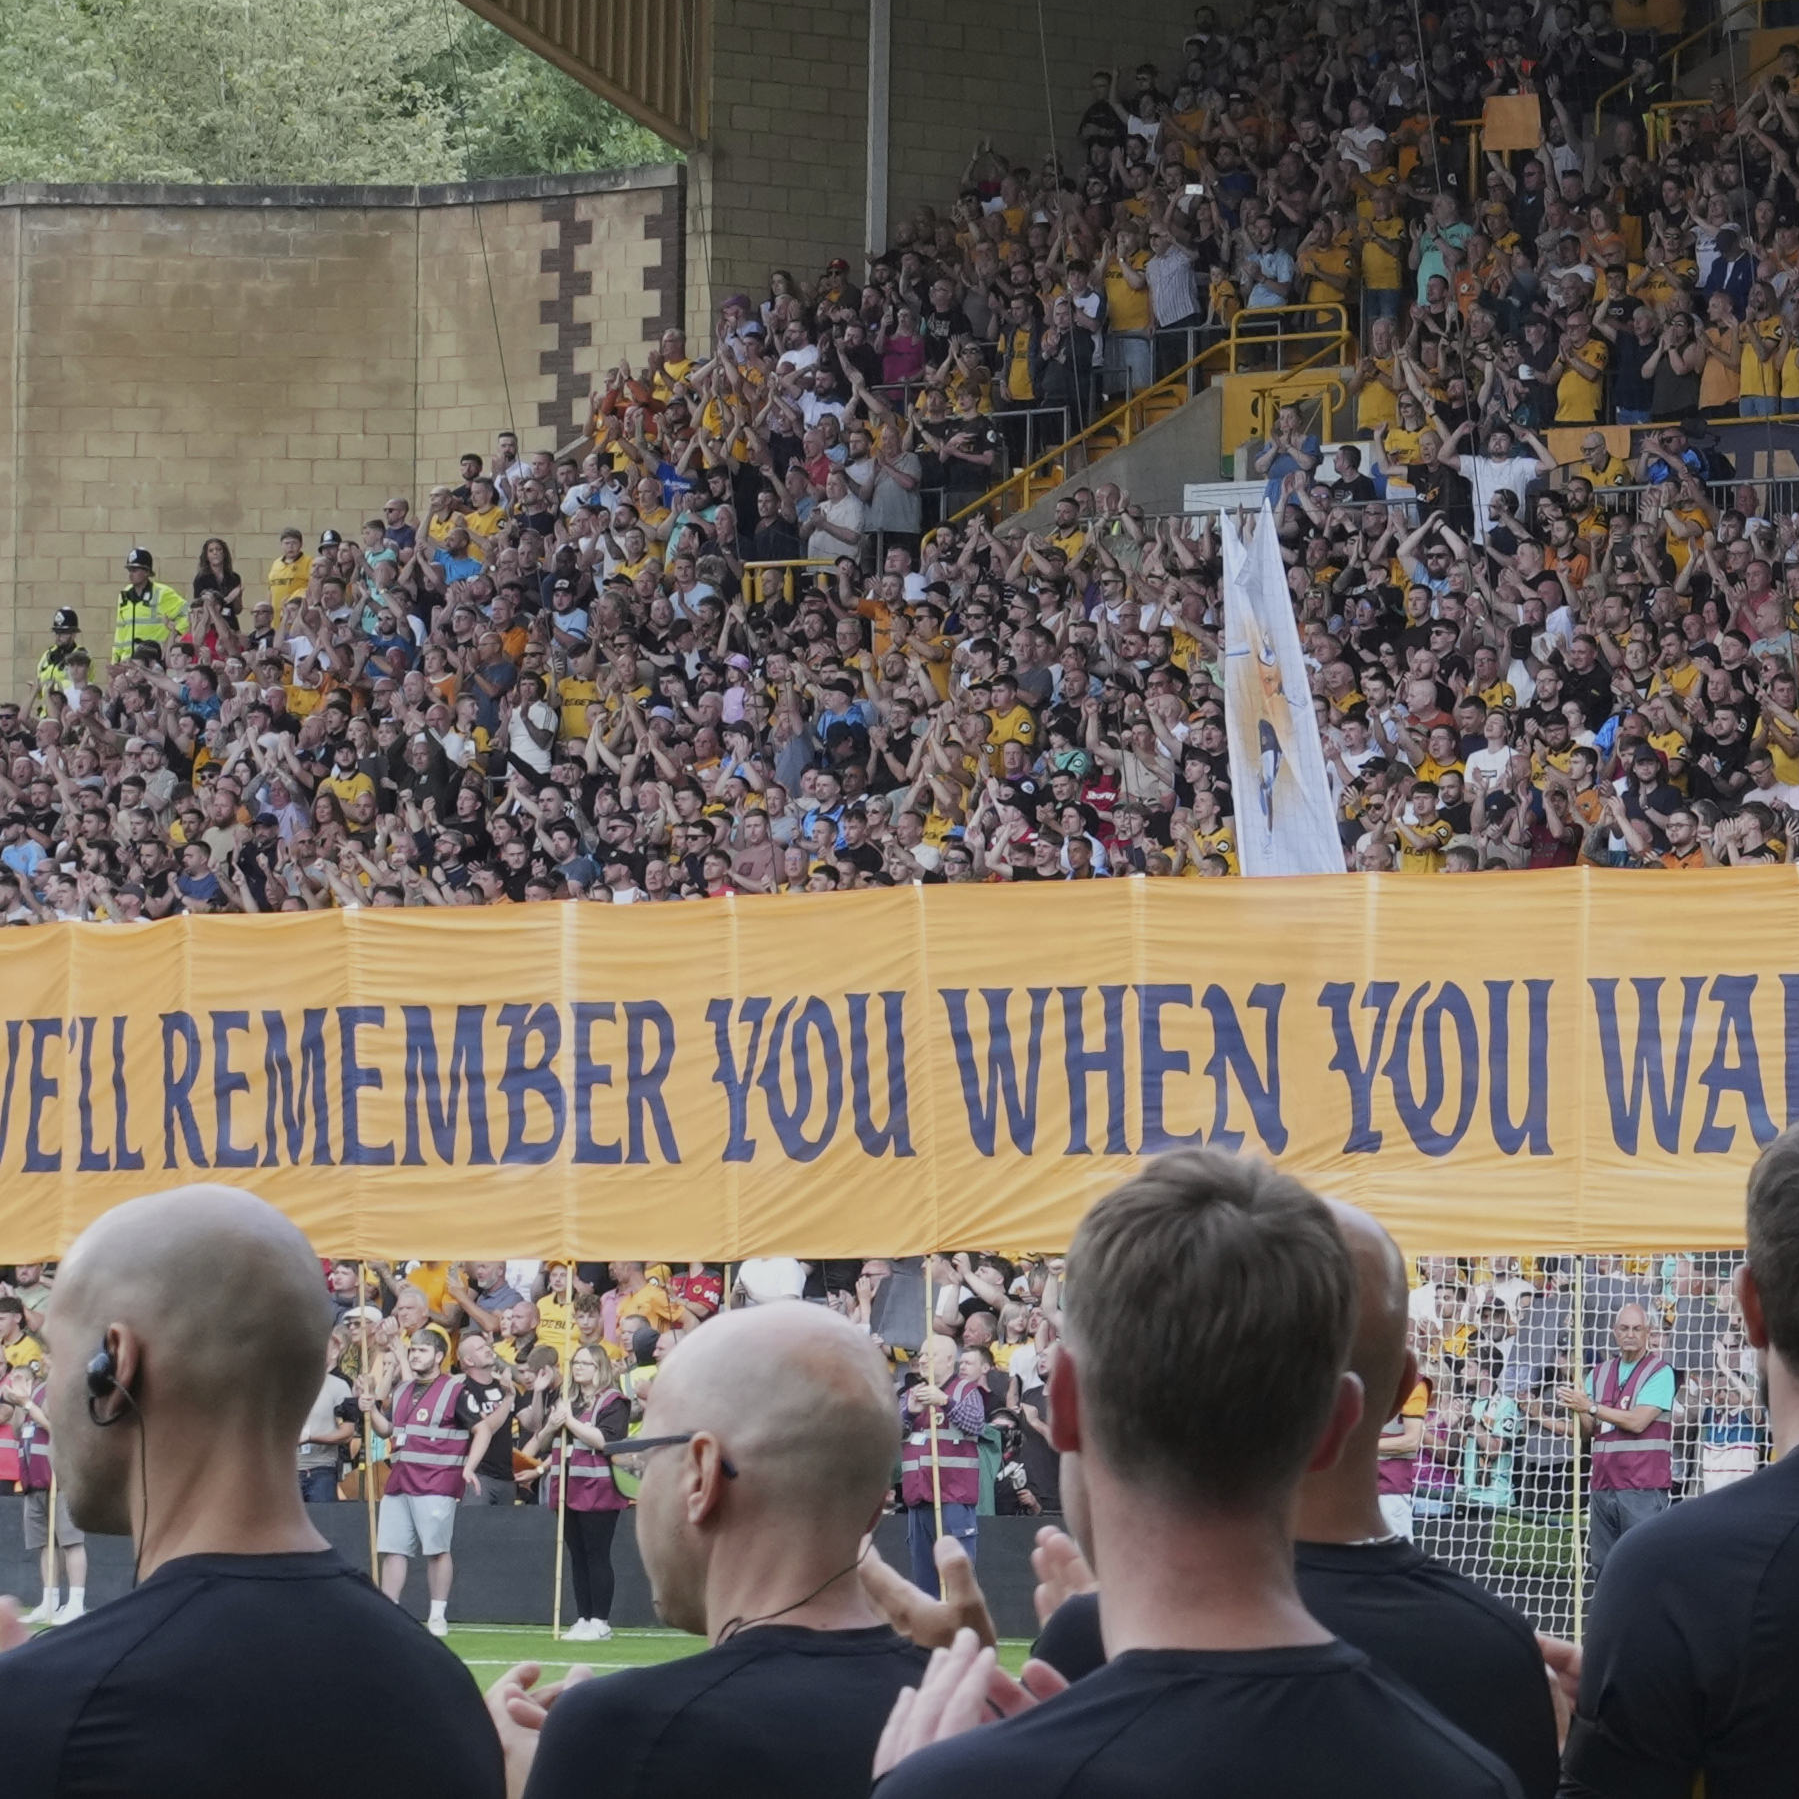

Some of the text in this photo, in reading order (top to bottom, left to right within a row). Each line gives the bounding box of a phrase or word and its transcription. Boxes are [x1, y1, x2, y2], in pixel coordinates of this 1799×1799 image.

[0, 1016, 144, 1173] E'LL
[163, 1000, 680, 1167] REMEMBER
[707, 991, 914, 1162] YOU
[939, 983, 1288, 1156] WHEN
[1316, 979, 1554, 1157] YOU
